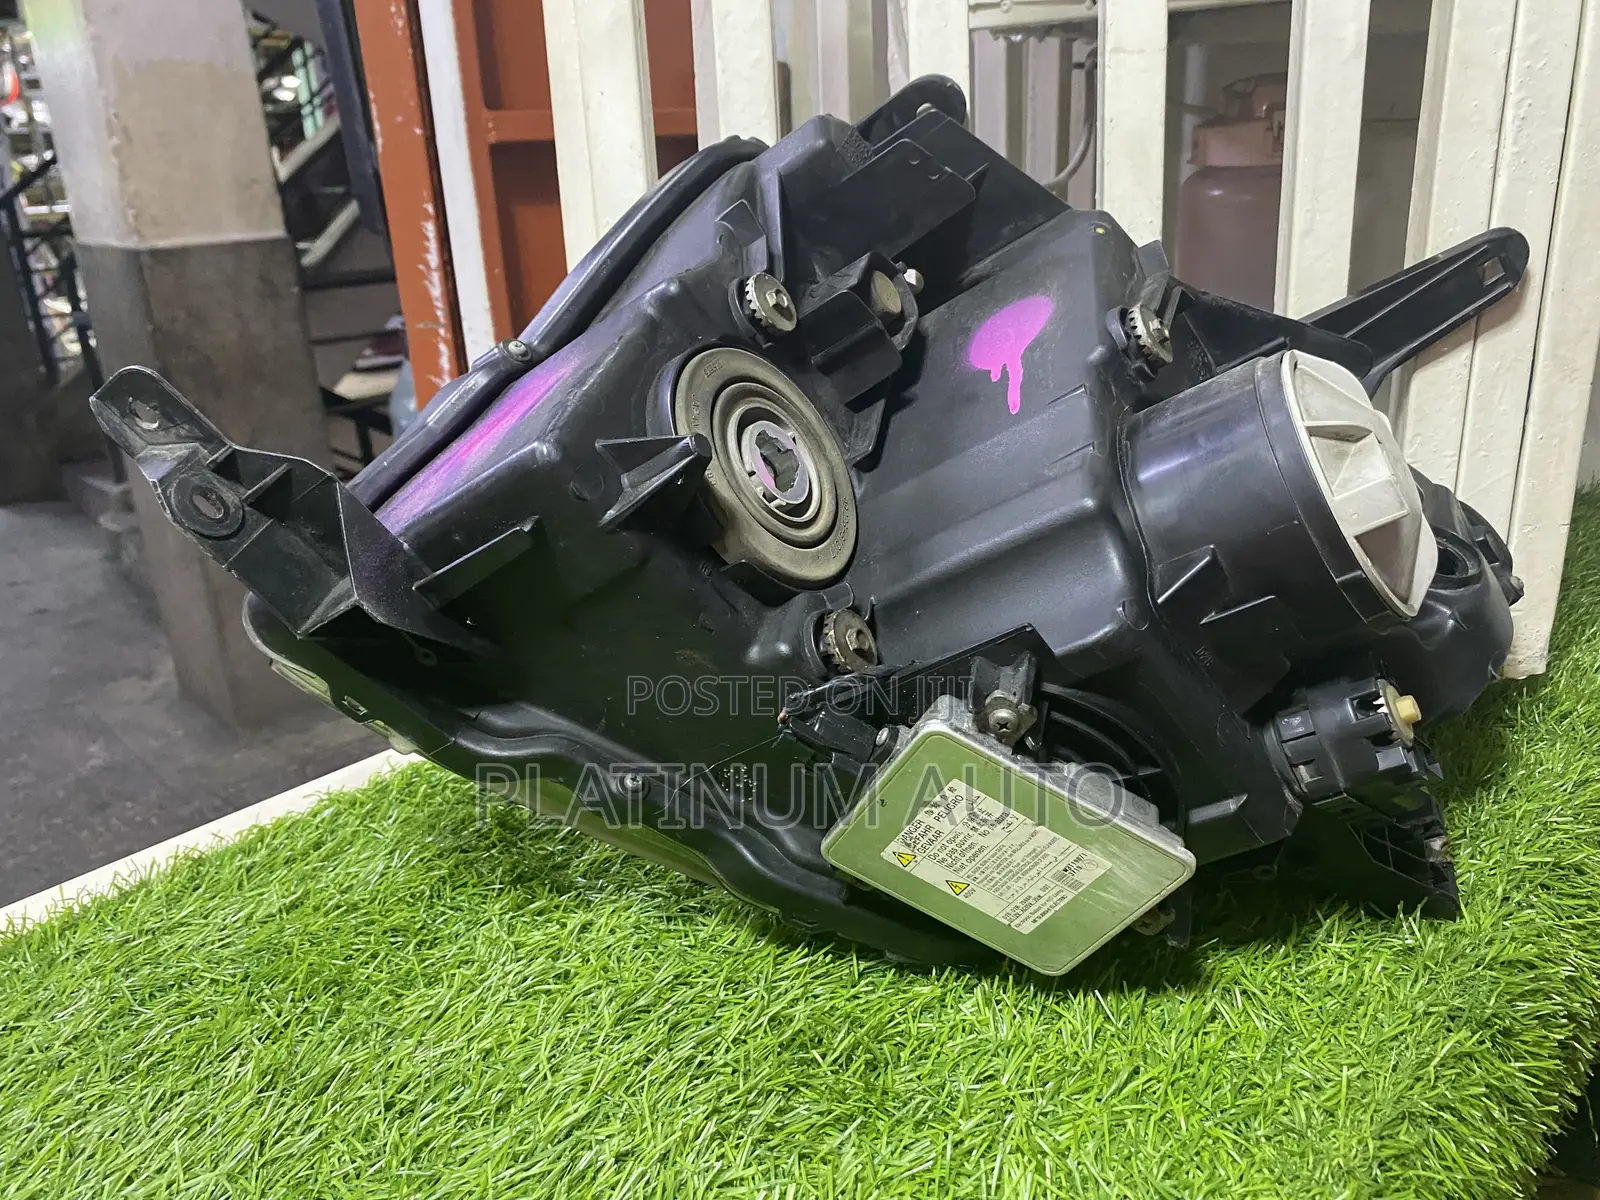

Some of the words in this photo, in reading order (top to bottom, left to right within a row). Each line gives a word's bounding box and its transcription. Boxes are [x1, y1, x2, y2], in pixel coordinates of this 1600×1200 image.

[905, 824, 935, 849] EFAHR
[933, 794, 964, 822] PELIGRO
[916, 829, 945, 854] GEVAAR
[978, 829, 991, 838] No
[927, 852, 940, 861] Do
[937, 843, 949, 854] not
[945, 847, 959, 859] pas
[965, 845, 989, 864] openen.
